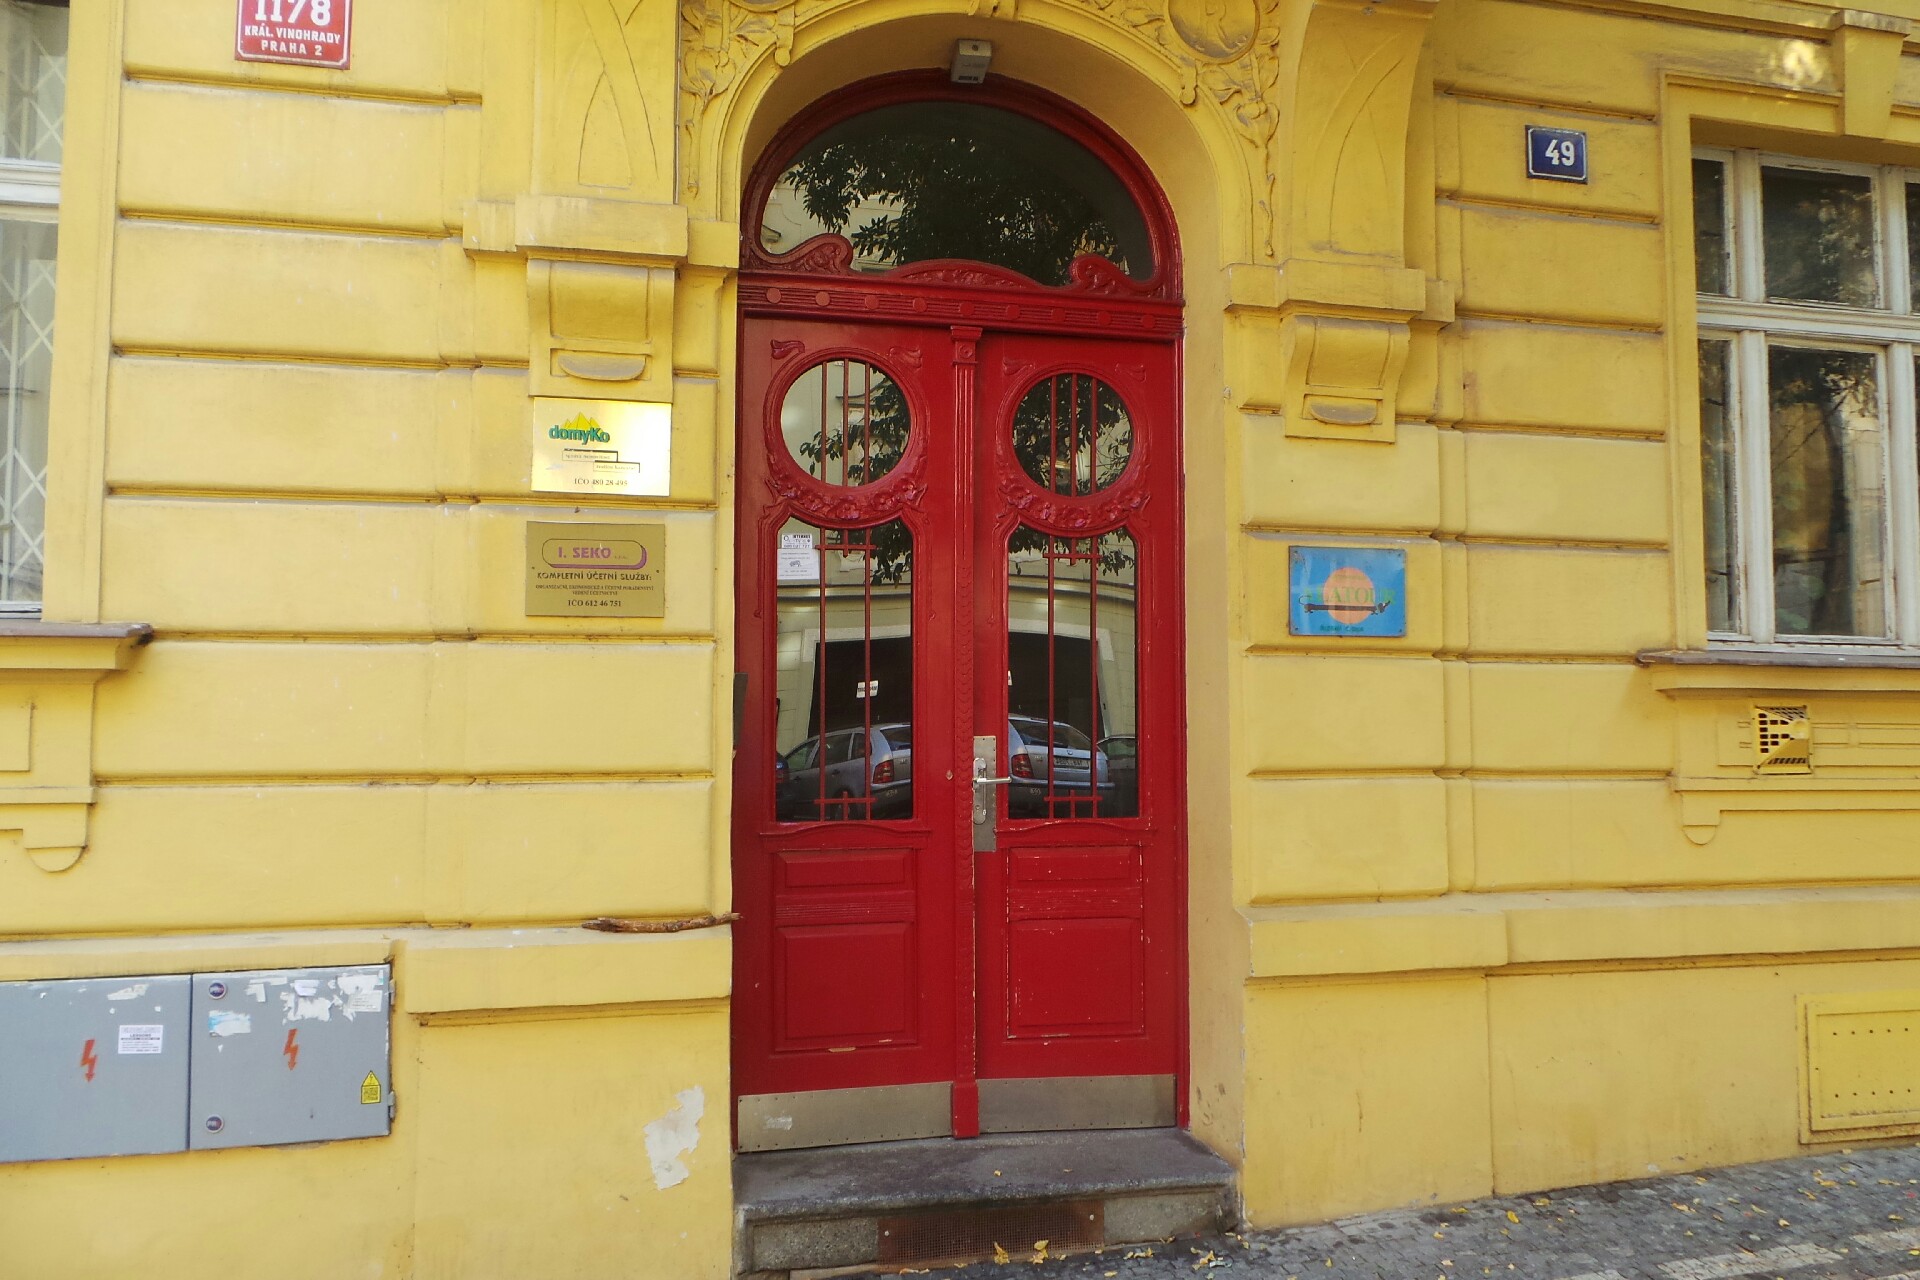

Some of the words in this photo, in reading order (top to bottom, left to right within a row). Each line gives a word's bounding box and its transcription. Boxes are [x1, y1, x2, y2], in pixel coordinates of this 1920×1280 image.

[254, 0, 331, 26] 1178
[244, 23, 274, 38] KRÁL.
[276, 27, 341, 44] VINOHRADY
[261, 40, 307, 55] PRAHA
[314, 45, 323, 56] 2
[1544, 139, 1575, 167] 49
[548, 425, 611, 445] domyKo
[605, 478, 614, 487] 28
[557, 547, 567, 558] I.
[572, 547, 612, 559] SEKO
[537, 571, 584, 580] KOMPLETNÍ
[586, 570, 617, 581] ÚČETNÍ
[620, 572, 652, 581] SLUŽBY:
[585, 599, 598, 607] 612
[610, 600, 622, 608] 751
